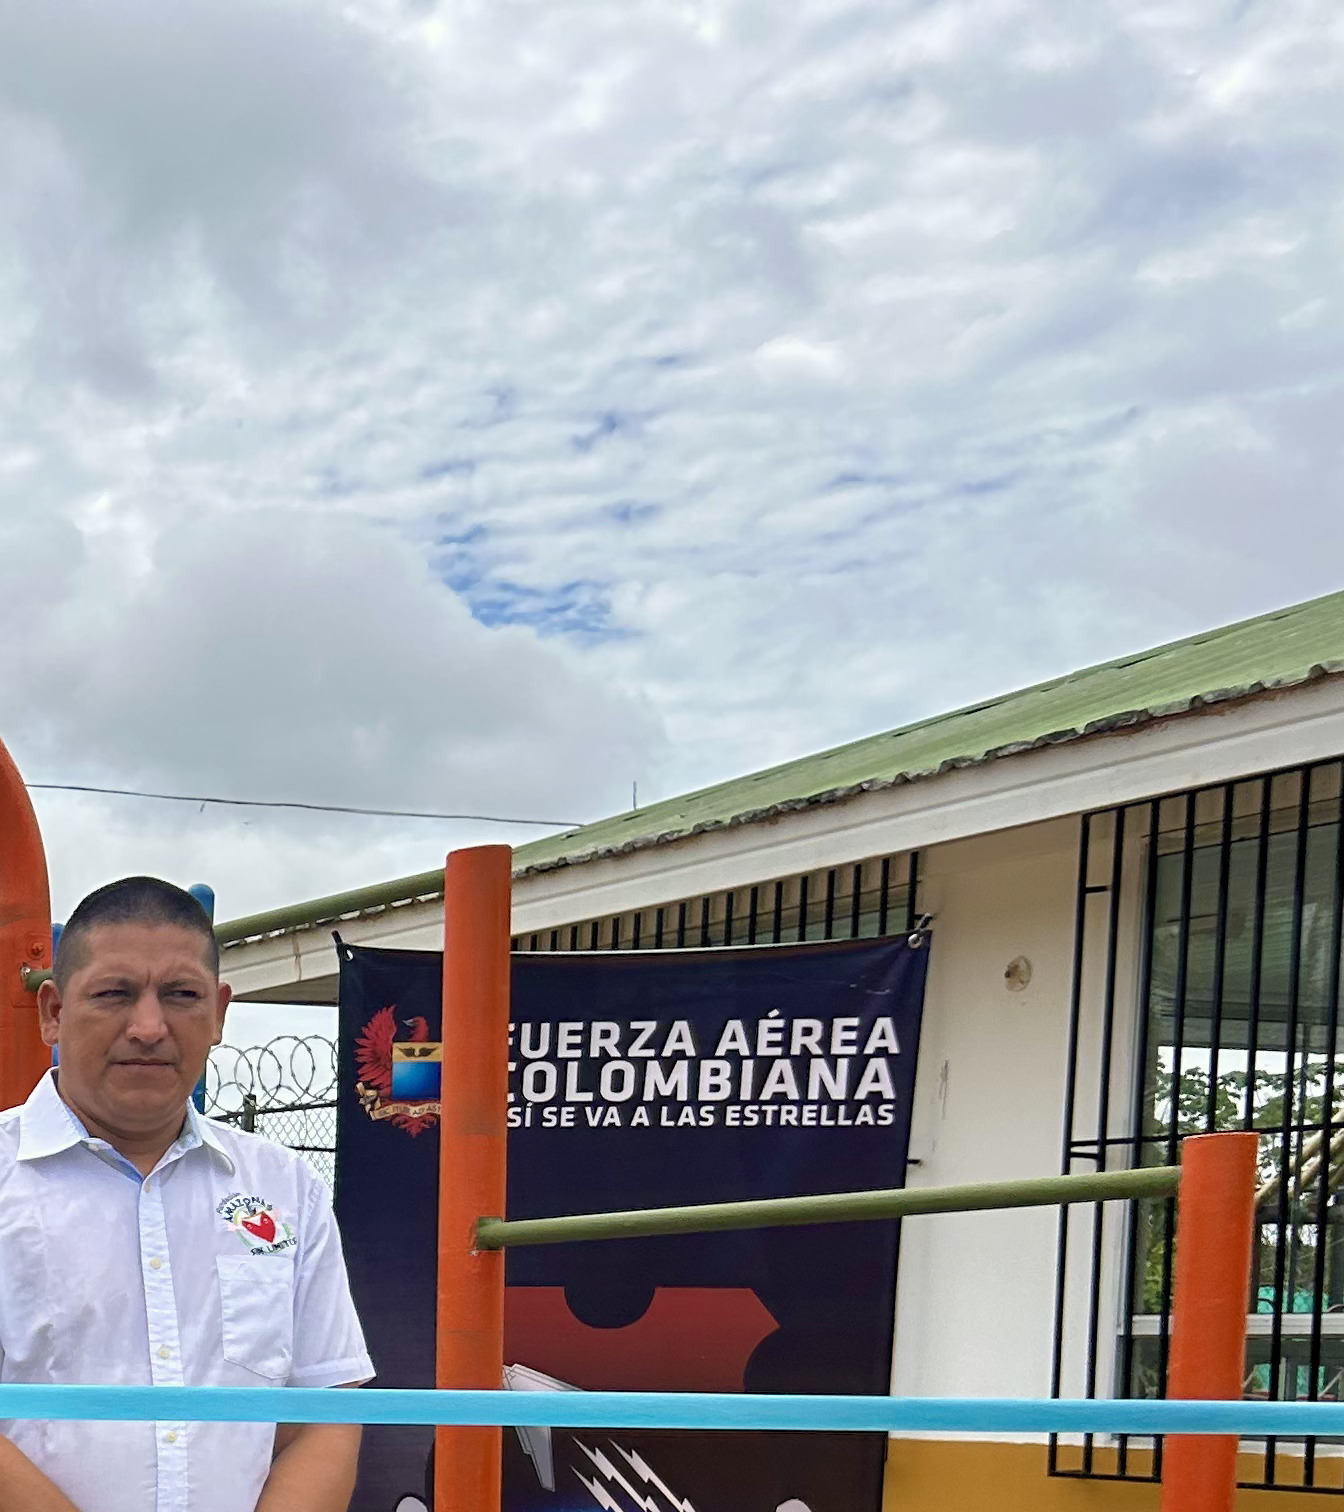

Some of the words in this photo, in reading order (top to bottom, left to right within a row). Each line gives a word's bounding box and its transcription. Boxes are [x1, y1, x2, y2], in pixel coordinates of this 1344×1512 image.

[714, 1008, 900, 1057] AÉREA
[541, 1106, 576, 1128] SE
[584, 1105, 623, 1127] VA
[630, 1105, 650, 1127] A
[659, 1105, 716, 1127] LAS
[725, 1103, 896, 1127] ESTRELLAS
